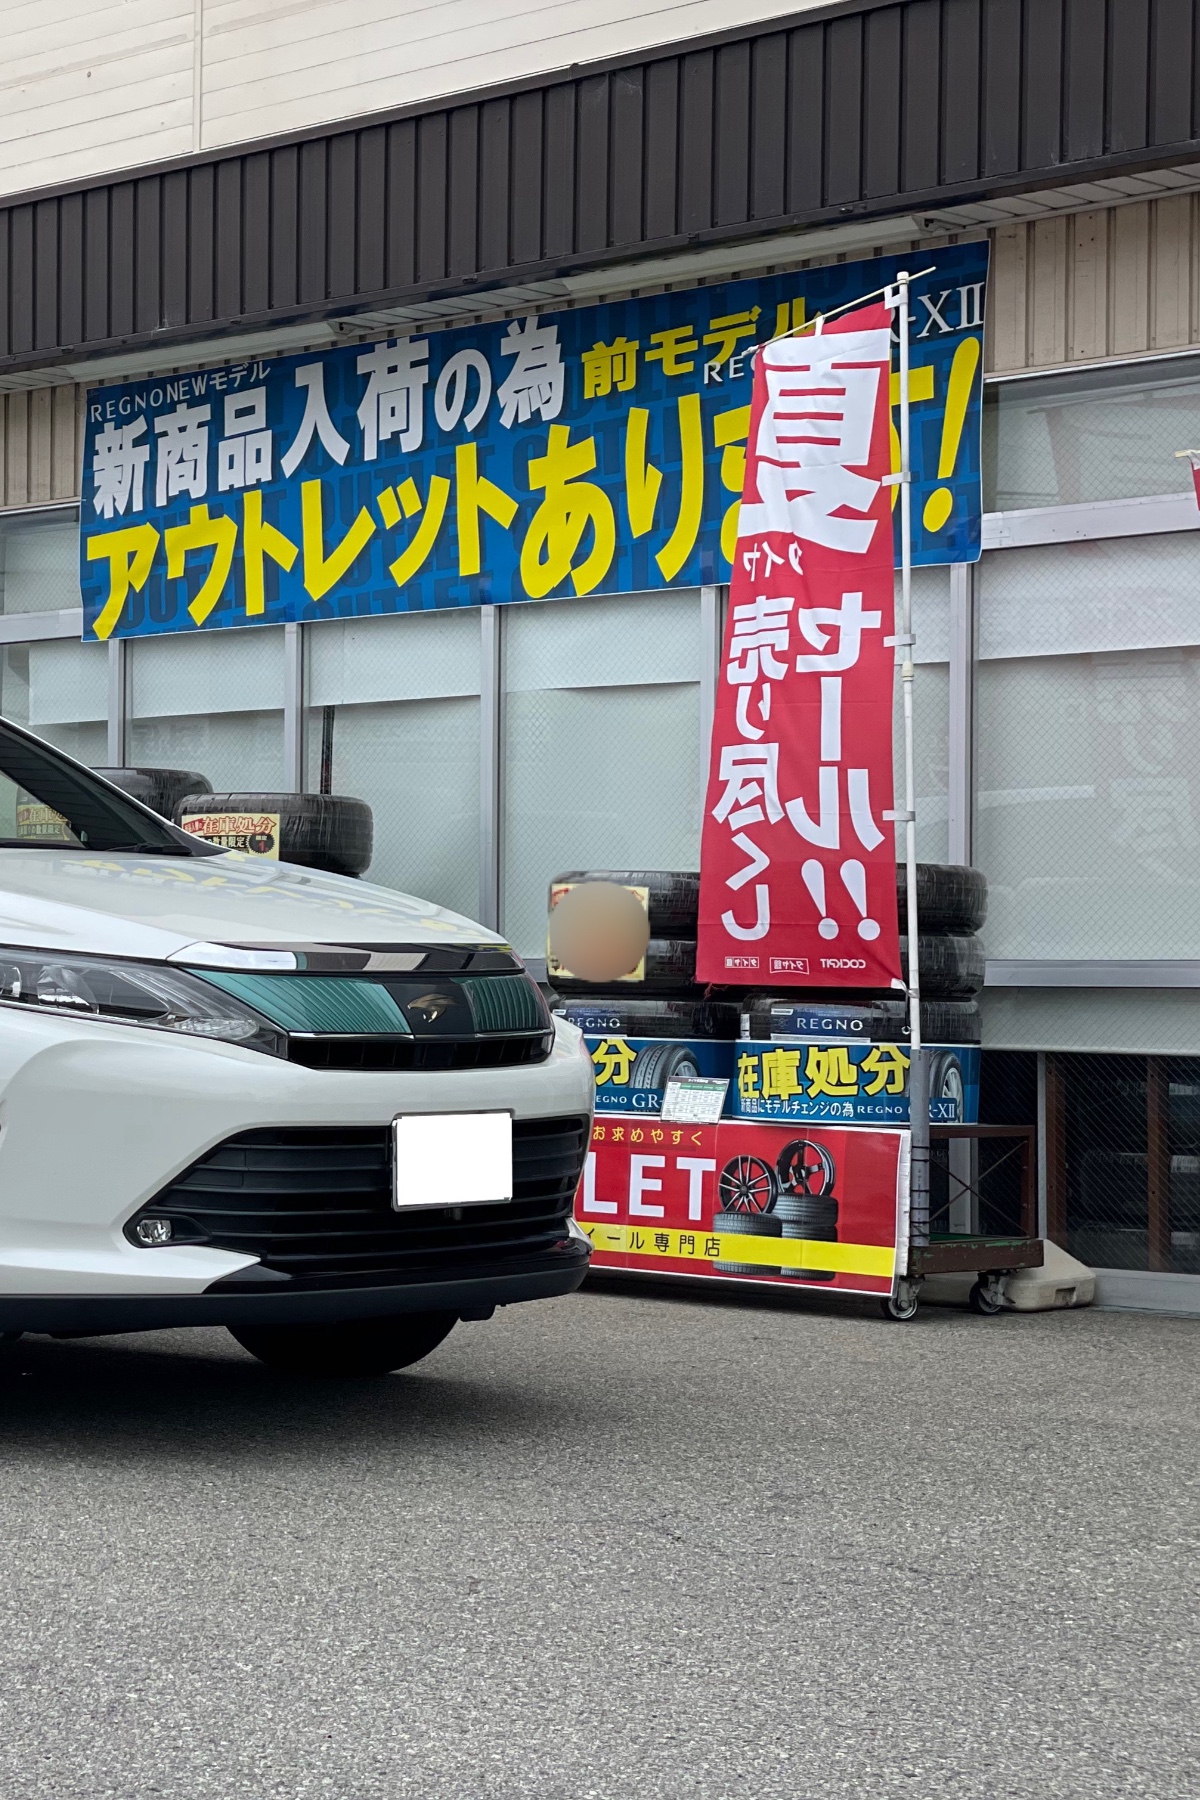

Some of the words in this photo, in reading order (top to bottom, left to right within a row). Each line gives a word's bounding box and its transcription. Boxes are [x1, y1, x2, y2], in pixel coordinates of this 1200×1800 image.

[93, 316, 565, 520] 新商品入荷の為
[581, 297, 824, 399] 前モデル
[203, 815, 277, 835] 在庫処分
[796, 1017, 864, 1031] REGNO
[737, 1043, 911, 1101] 在庫処分
[857, 1105, 903, 1114] REGNO
[592, 1125, 702, 1146] お求めやすく
